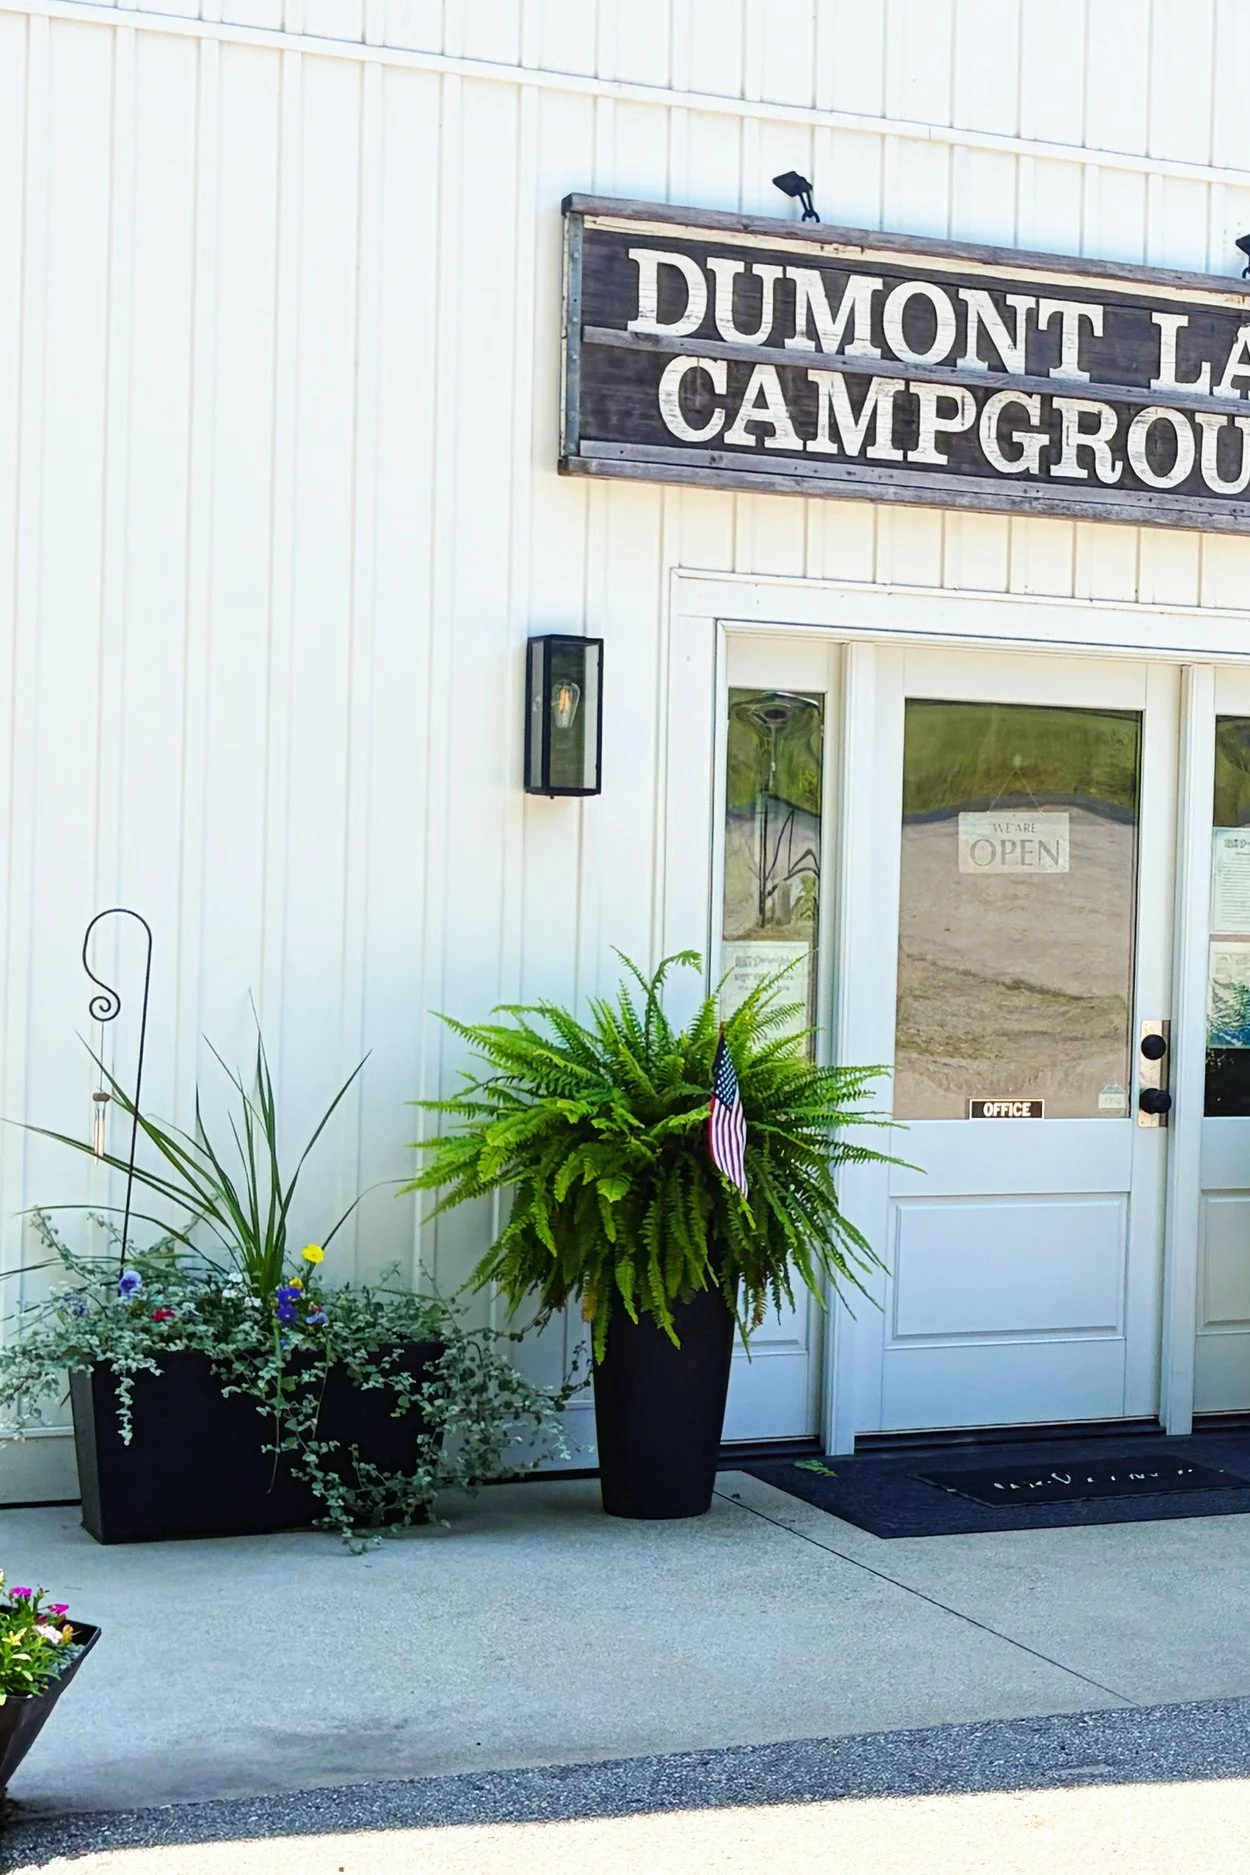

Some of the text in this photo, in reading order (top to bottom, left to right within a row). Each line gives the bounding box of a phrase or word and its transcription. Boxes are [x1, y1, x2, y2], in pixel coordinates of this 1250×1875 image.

[627, 247, 1104, 383] DUMONT
[992, 822, 1037, 834] WE ARE
[970, 838, 1060, 867] OPEN
[983, 1102, 1032, 1117] OFFICE
